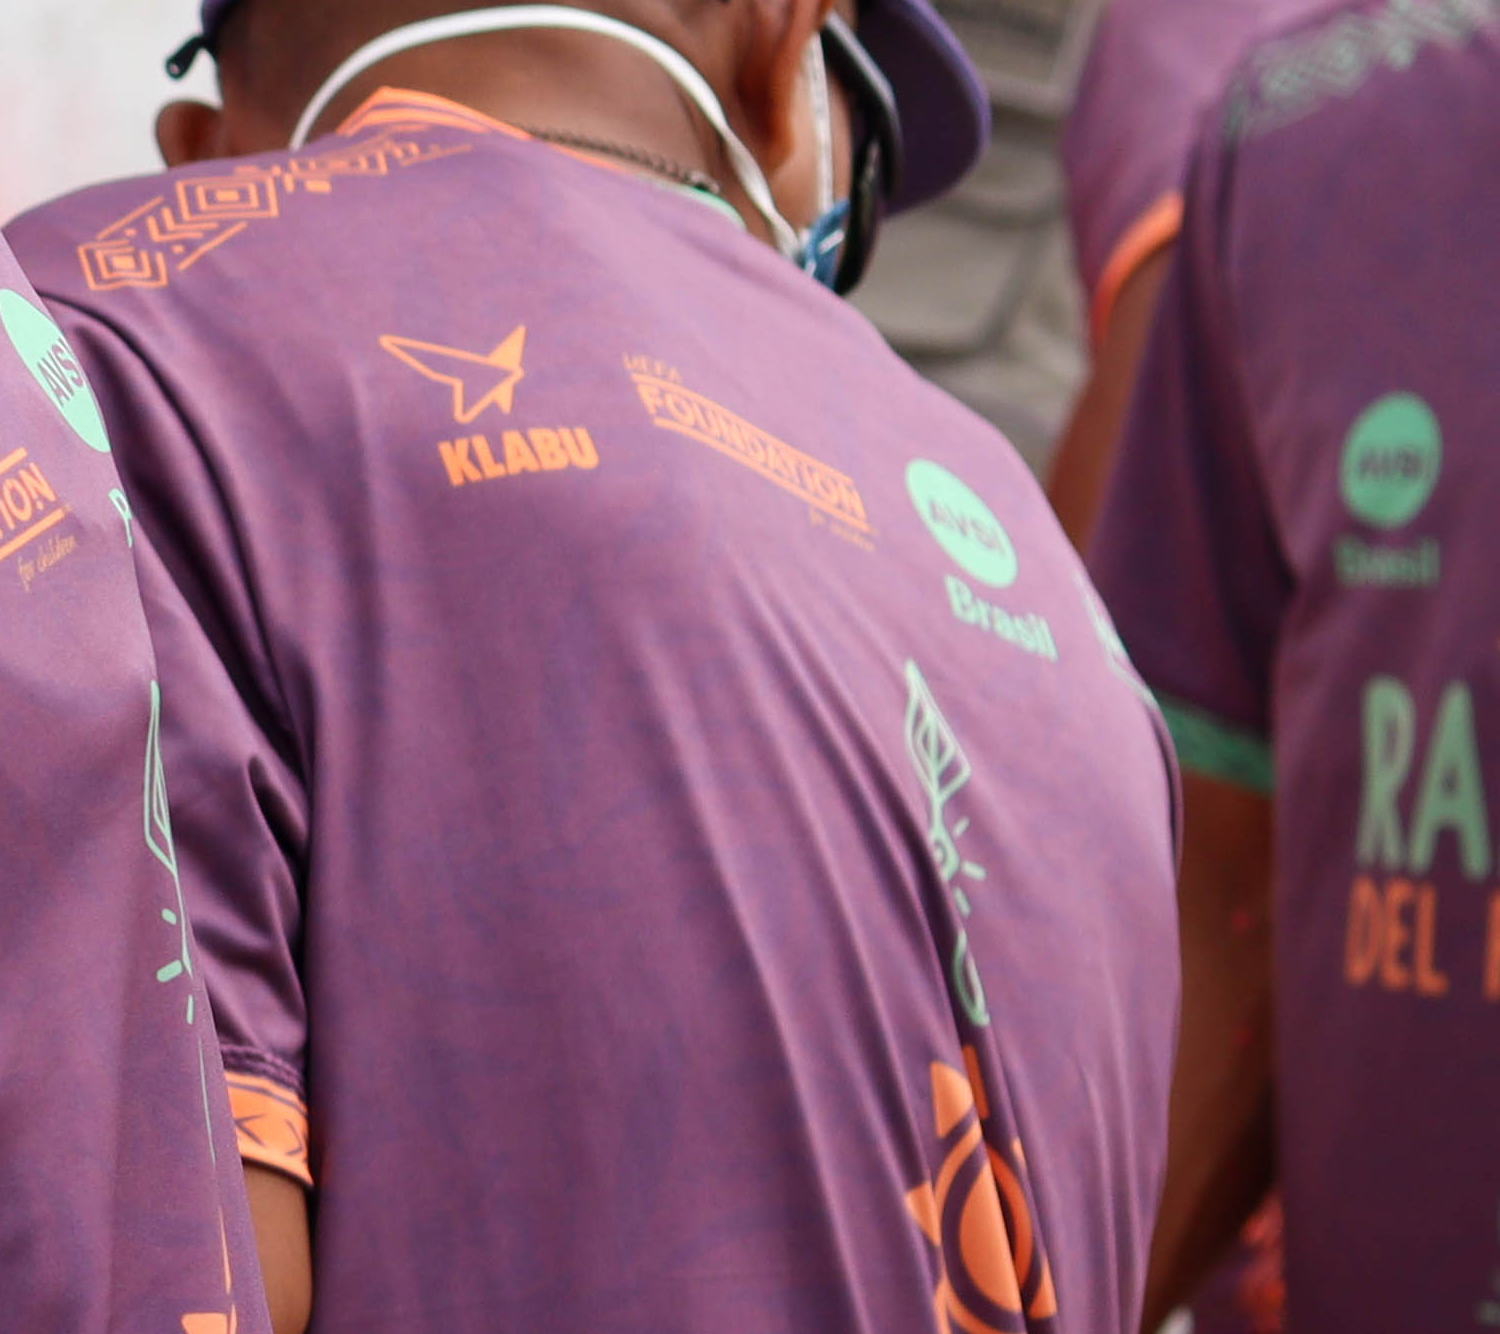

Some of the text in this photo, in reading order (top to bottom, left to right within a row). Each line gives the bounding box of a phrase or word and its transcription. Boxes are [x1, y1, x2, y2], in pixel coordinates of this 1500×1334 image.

[437, 427, 599, 486] KLABU
[636, 383, 868, 523] FOUNDATION
[944, 574, 1059, 662] Brasil
[1355, 675, 1500, 881] RA
[1343, 874, 1450, 999] DEL
